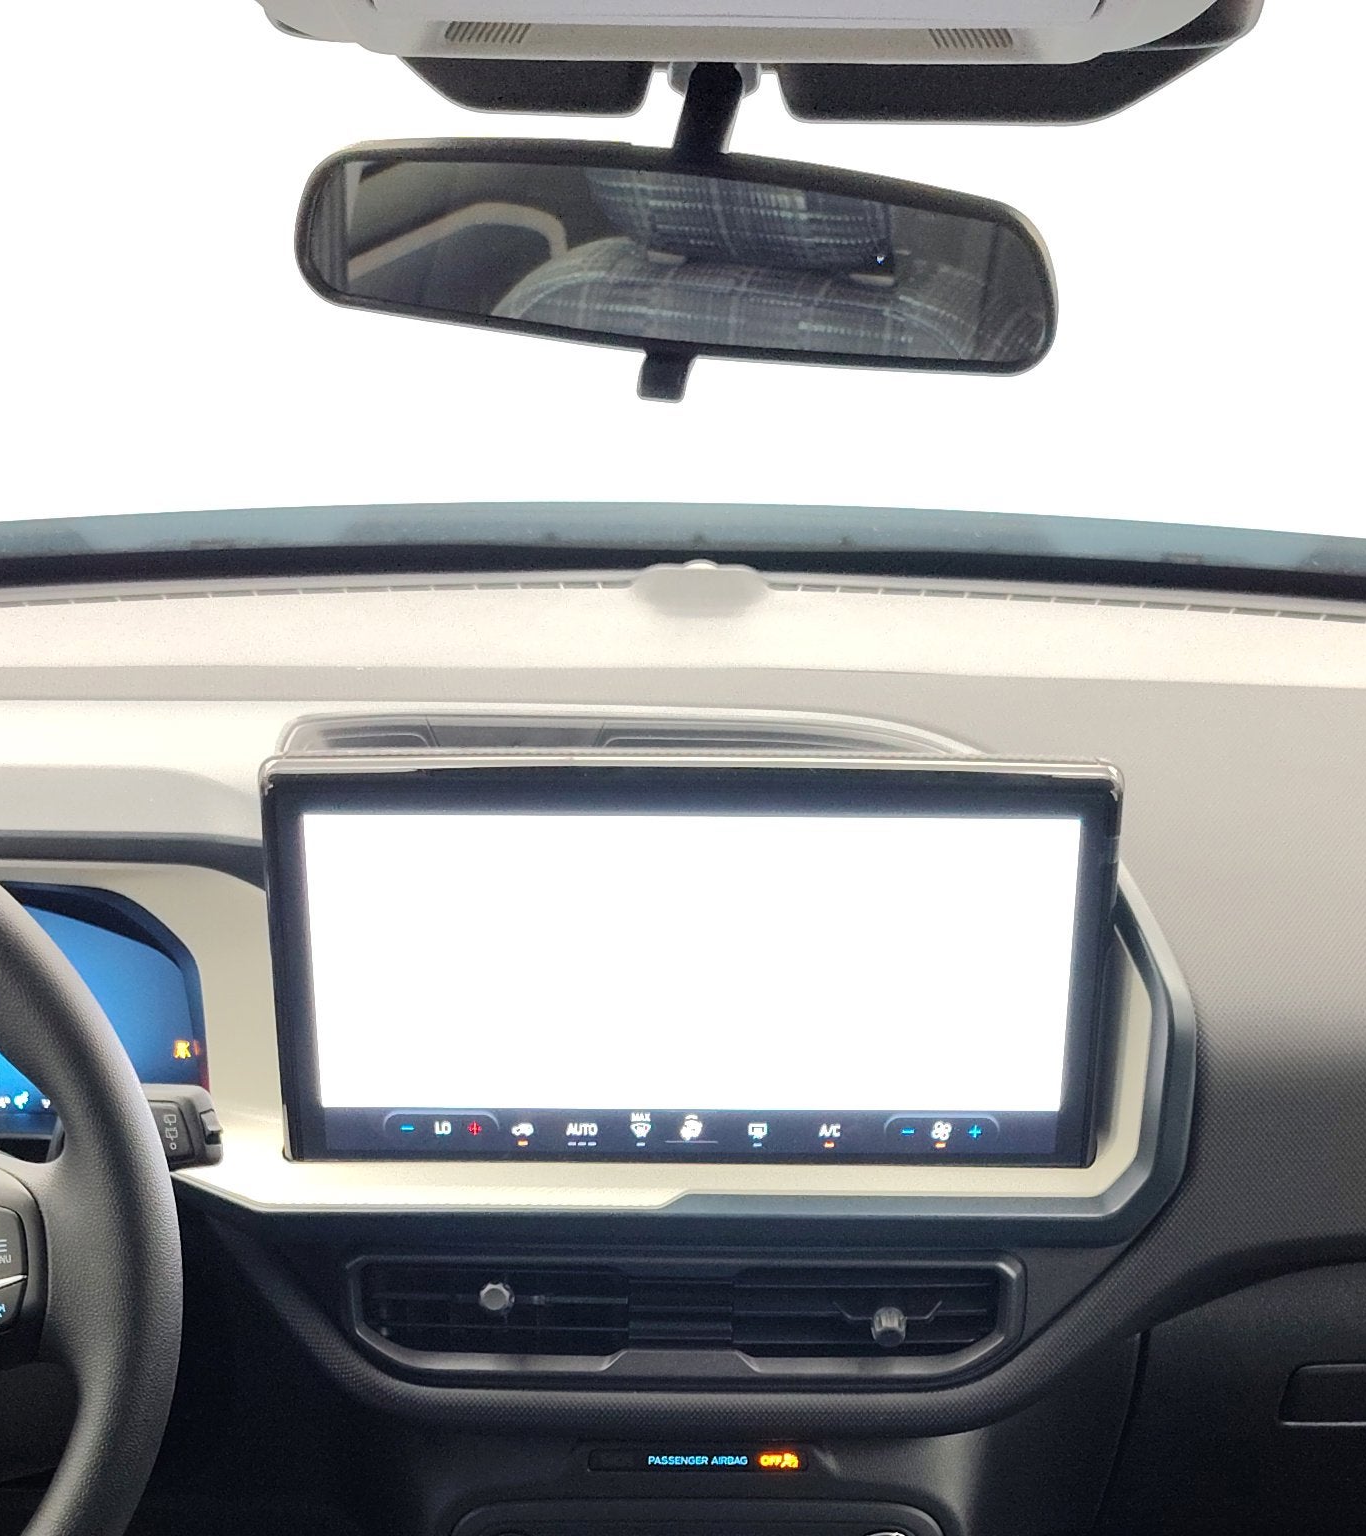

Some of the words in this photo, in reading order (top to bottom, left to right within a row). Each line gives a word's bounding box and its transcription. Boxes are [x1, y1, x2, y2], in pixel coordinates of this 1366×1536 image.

[630, 1112, 651, 1122] MAX
[435, 1121, 451, 1135] LO
[566, 1122, 598, 1136] AUTO
[818, 1123, 841, 1138] A/C
[648, 1455, 708, 1465] PASSENGER
[711, 1455, 748, 1466] AIRBAG
[760, 1454, 782, 1467] OFF
